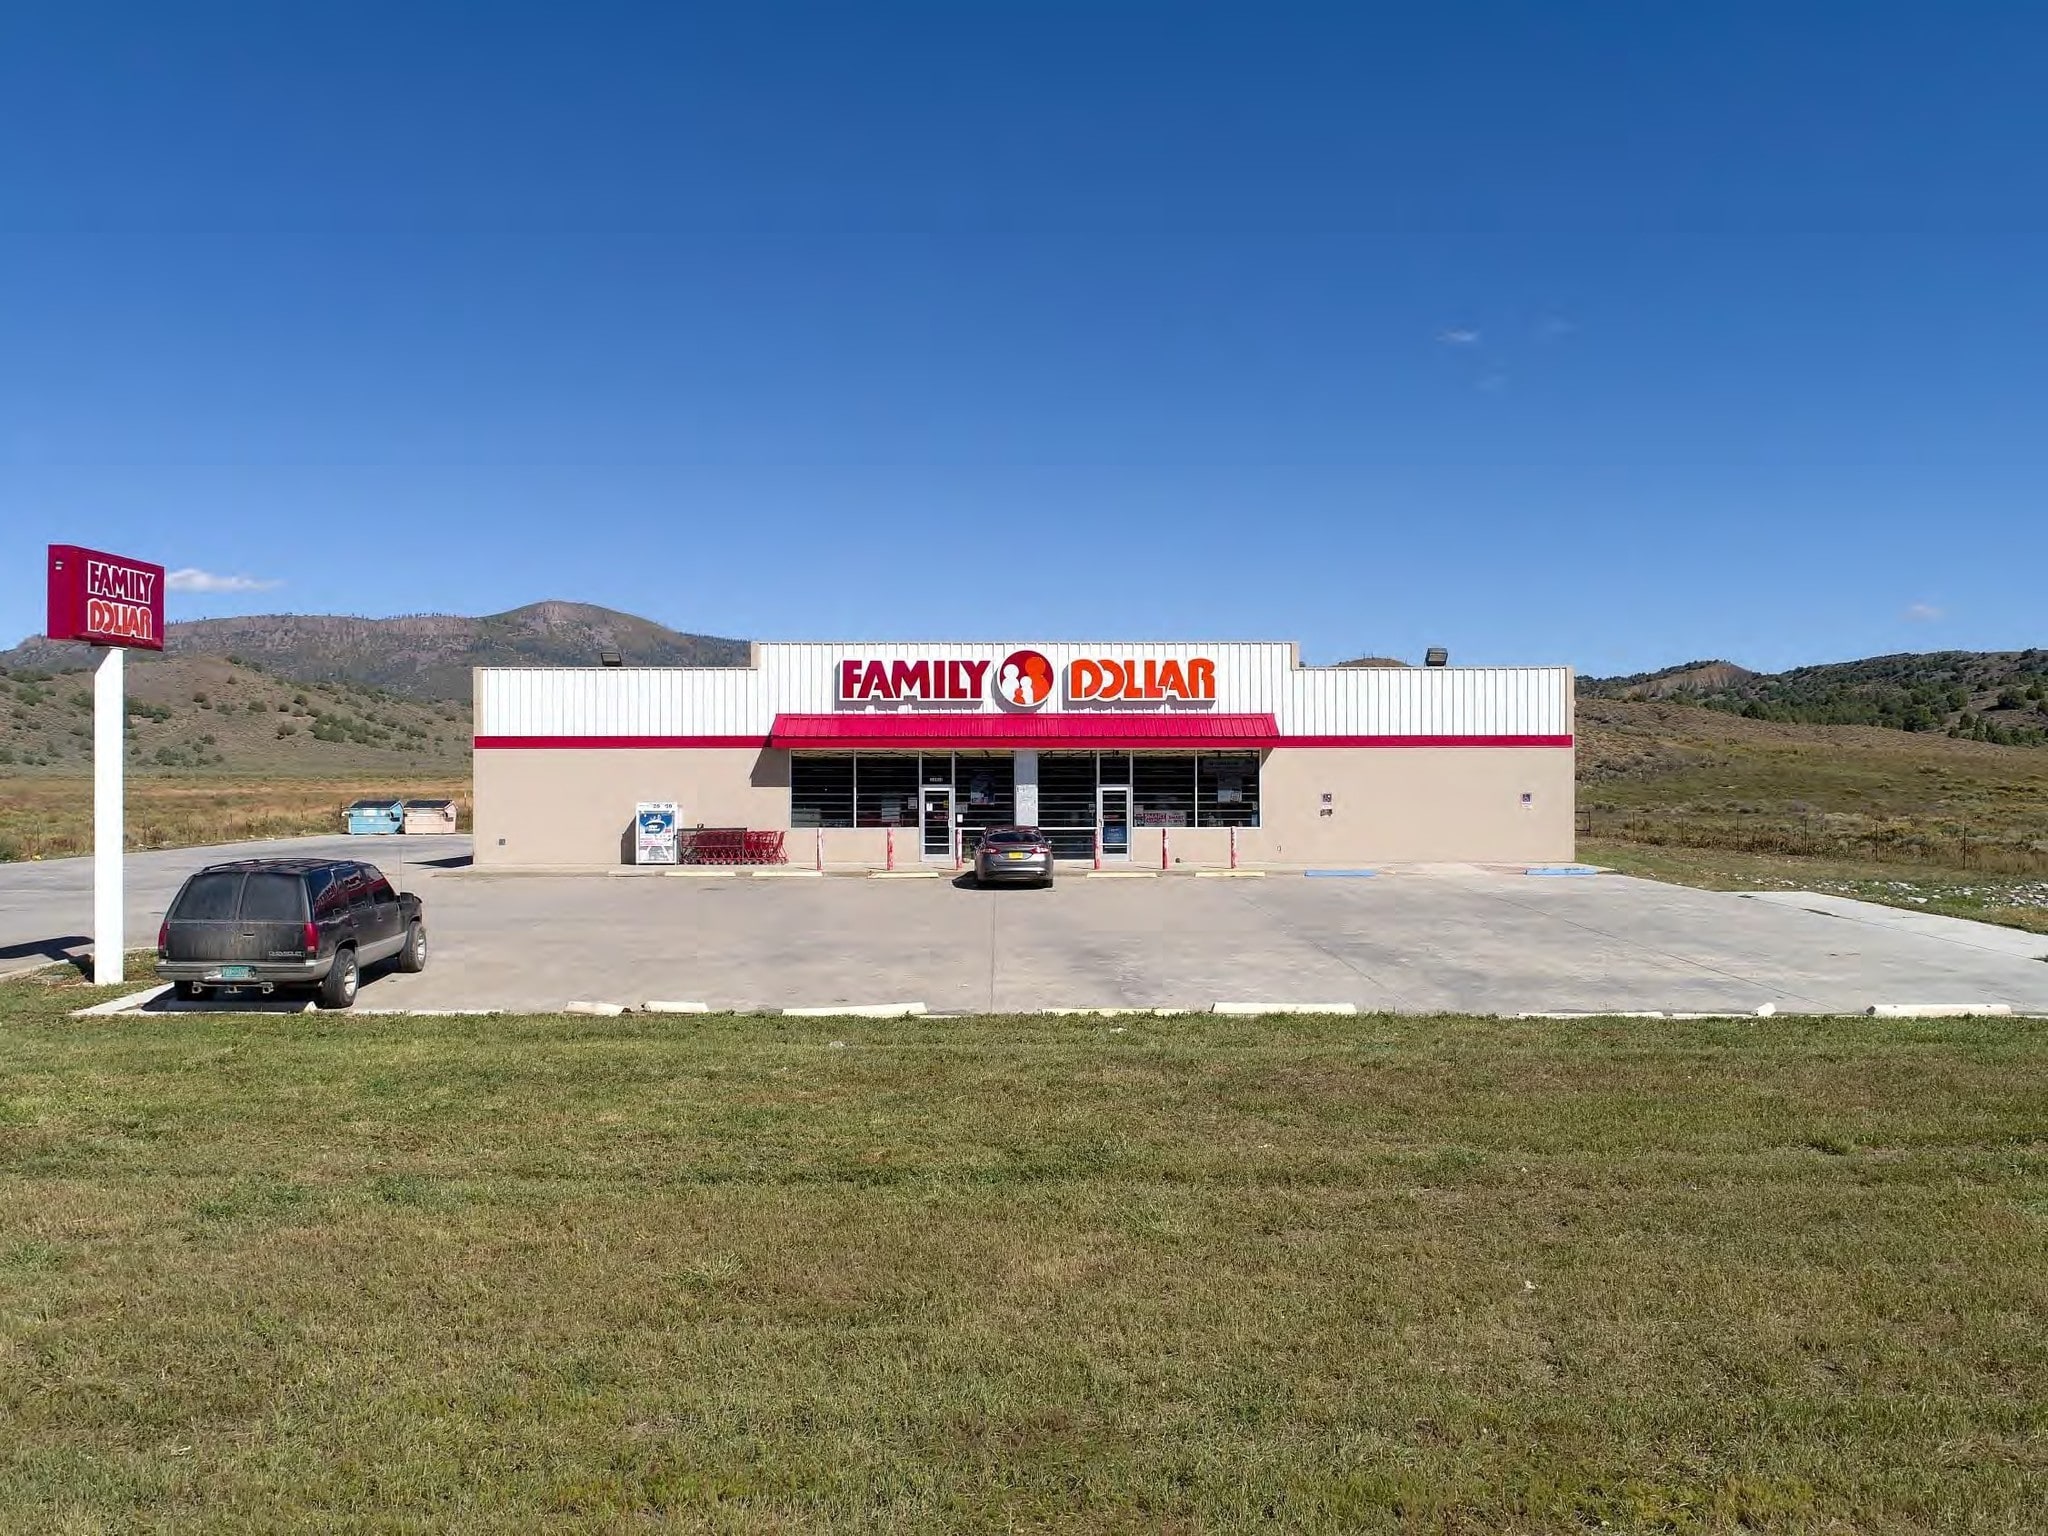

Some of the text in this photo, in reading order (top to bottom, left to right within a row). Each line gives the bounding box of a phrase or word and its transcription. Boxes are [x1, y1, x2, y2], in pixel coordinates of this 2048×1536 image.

[87, 560, 155, 604] FAMILY
[87, 598, 153, 640] DOLLAR
[841, 658, 1216, 699] FAMILY DOLLAR
